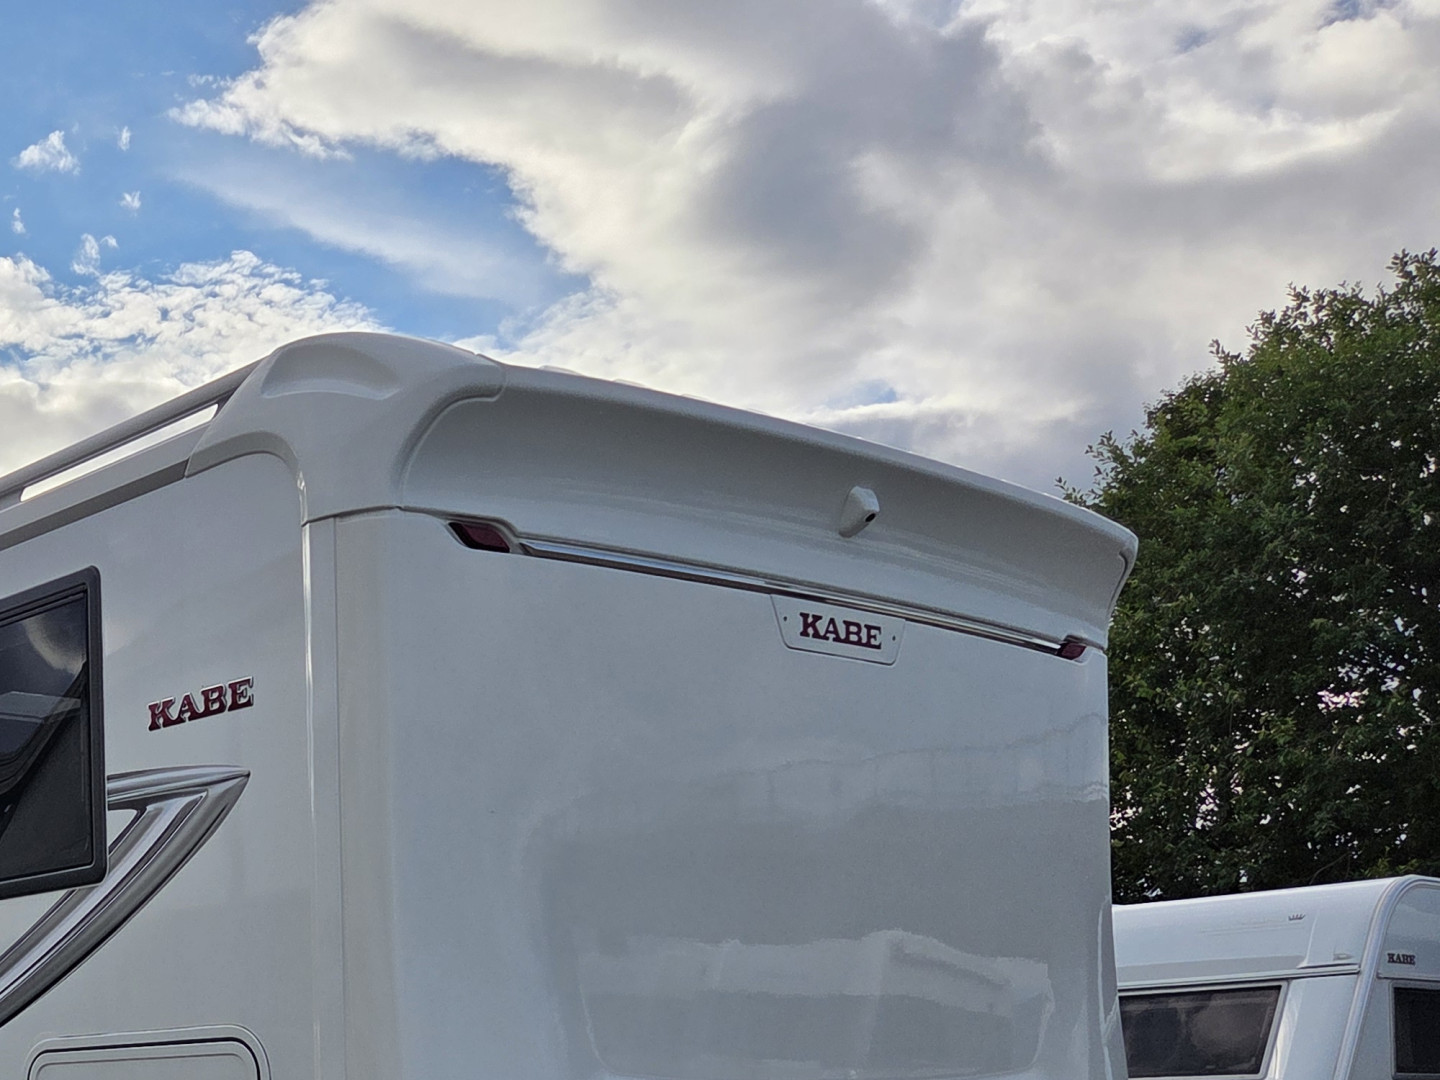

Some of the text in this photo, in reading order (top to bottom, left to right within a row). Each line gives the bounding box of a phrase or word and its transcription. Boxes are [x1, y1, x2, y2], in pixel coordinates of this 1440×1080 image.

[799, 611, 882, 650] KABE
[147, 676, 254, 732] KABE
[1387, 952, 1416, 966] KABE
